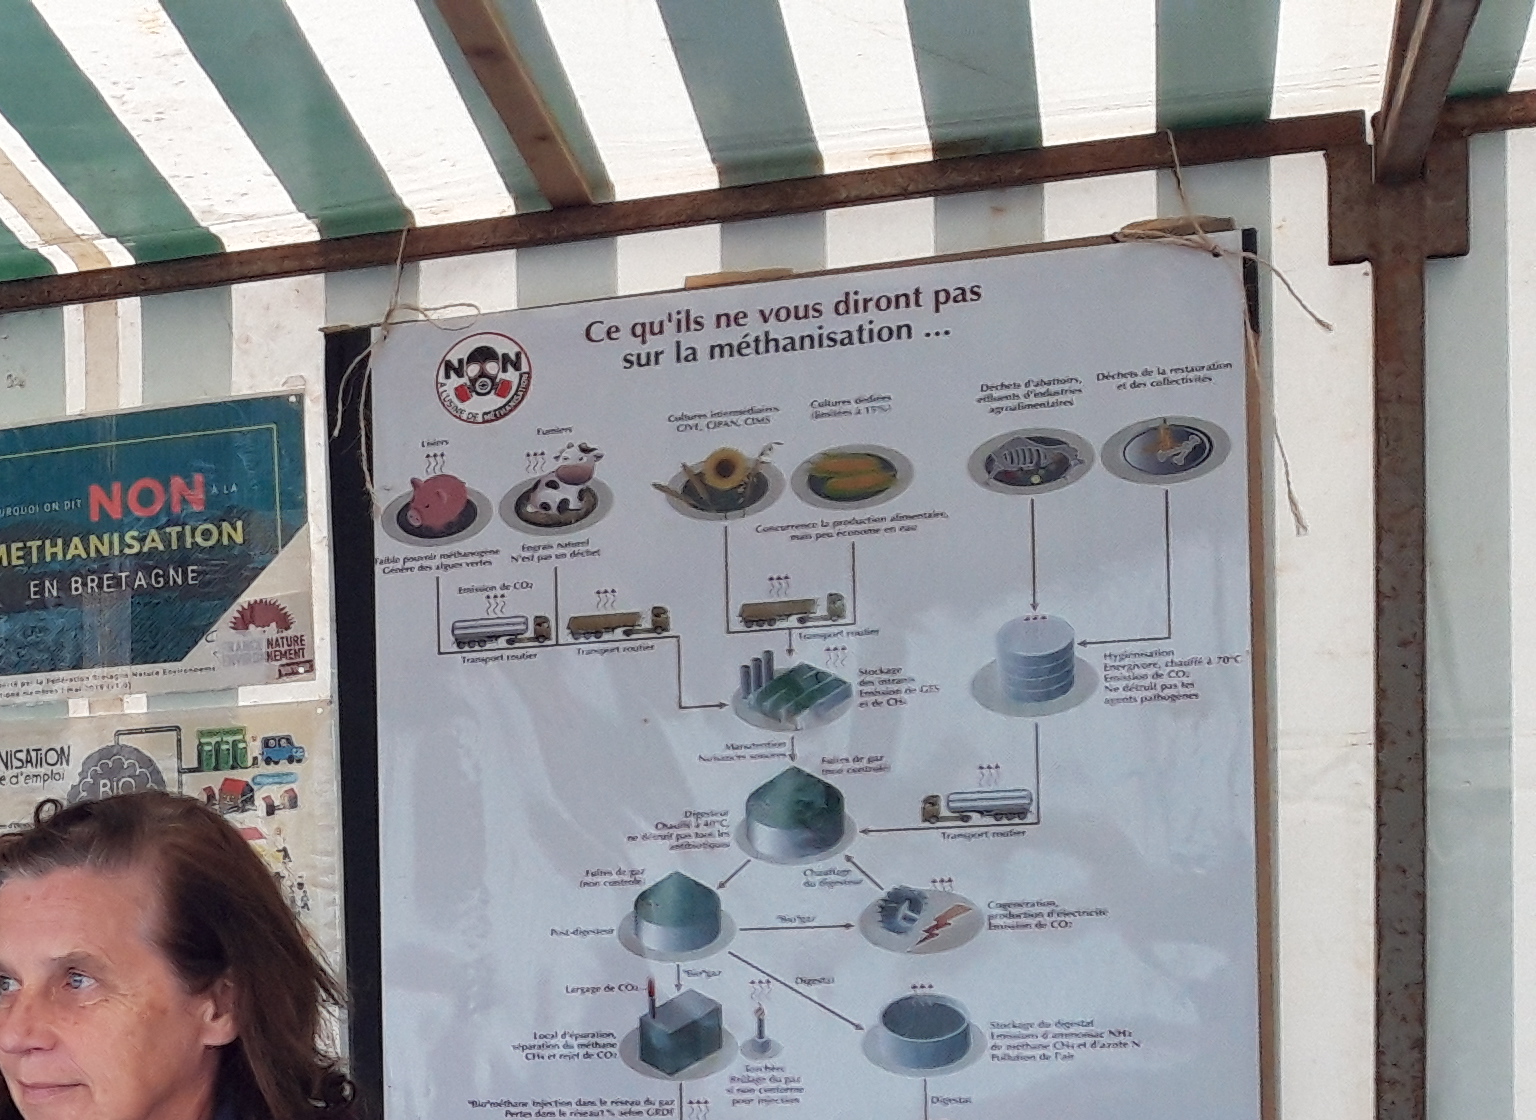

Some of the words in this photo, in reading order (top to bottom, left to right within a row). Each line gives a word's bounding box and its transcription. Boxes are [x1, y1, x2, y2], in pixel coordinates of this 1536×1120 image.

[584, 320, 621, 344] Ce
[630, 311, 706, 346] qu'ils
[715, 308, 750, 329] ne
[757, 300, 824, 325] vous
[833, 290, 923, 319] diront
[933, 283, 983, 315] pas
[622, 347, 665, 370] sur
[675, 340, 699, 364] la
[708, 320, 914, 359] méthanisation
[88, 473, 206, 522] NON
[223, 483, 237, 493] LA
[30, 579, 58, 600] EN
[70, 565, 199, 595] BRETAGNE
[266, 634, 306, 649] NATURE
[10, 769, 65, 789] d'emploi
